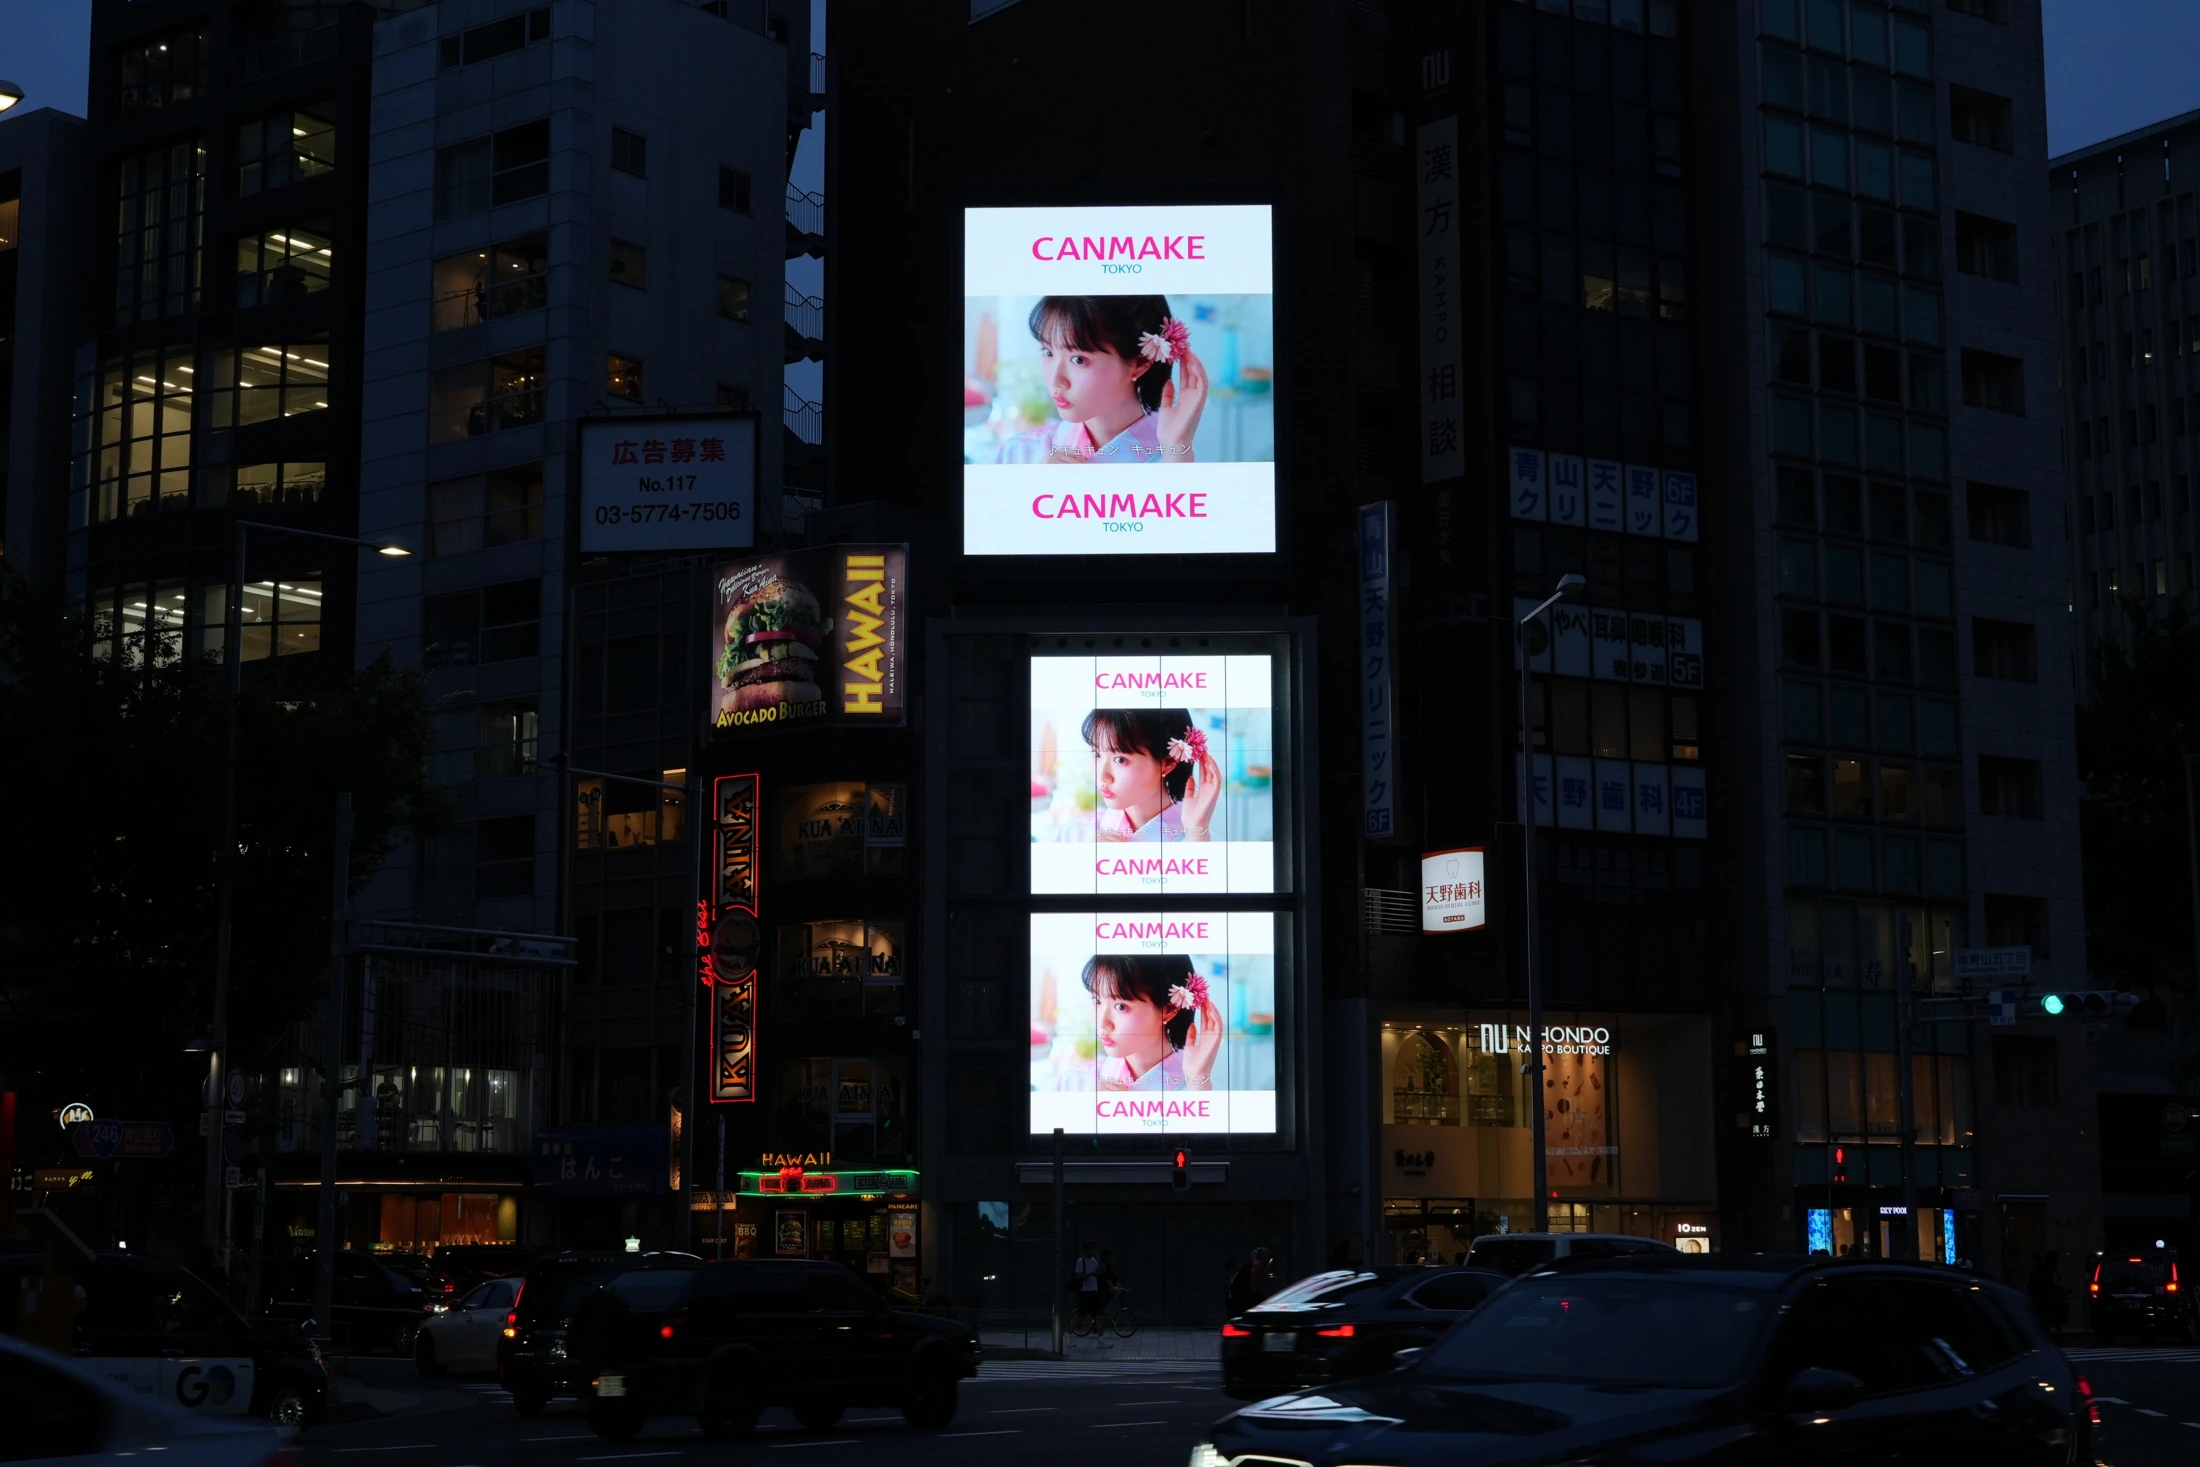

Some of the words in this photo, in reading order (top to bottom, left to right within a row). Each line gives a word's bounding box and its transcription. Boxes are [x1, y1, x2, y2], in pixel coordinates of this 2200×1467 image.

[1424, 143, 1453, 237] 漢方
[1031, 236, 1206, 261] CANMAKE
[1101, 264, 1143, 274] TOKYO
[1432, 256, 1448, 343] KAMPO
[1427, 363, 1458, 458] 相談
[612, 437, 726, 466] 広告募集
[1060, 444, 1120, 456] キュキュン
[1130, 444, 1191, 456] キュキュン
[638, 475, 697, 493] No.117
[1516, 452, 1655, 499] 青山天野
[1666, 475, 1694, 504] 6F
[595, 501, 741, 525] 03-5774-7506
[1031, 493, 1207, 519] CANMAKE
[1518, 488, 1691, 536] クリニック
[1102, 522, 1144, 532] TOKYO
[844, 555, 887, 714] HAWAII
[1364, 512, 1387, 804] 青山天野クリニック
[1612, 659, 1666, 682] 表参道
[1673, 654, 1700, 684] 5F
[1096, 672, 1208, 689] CANMAKE
[1533, 776, 1664, 815] 天野歯科
[1675, 789, 1704, 818] 4F
[799, 819, 832, 838] KUA
[1105, 826, 1153, 836] キュキュン
[1161, 826, 1208, 836] キュキュン
[1367, 810, 1390, 833] 6F
[1096, 859, 1209, 876] CANMAKE
[1141, 877, 1168, 885] TOKYO
[1425, 880, 1482, 905] 天野歯科
[1096, 923, 1209, 939] CANMAKE
[798, 954, 832, 976] KUA
[1957, 951, 2027, 967] 南青山五丁目
[720, 979, 752, 1092] KUA
[1516, 1025, 1610, 1044] NHONDO
[1557, 1045, 1610, 1056] BOUTIQUE
[230, 1079, 244, 1098] 40
[1162, 1075, 1211, 1085] キュキュン
[1096, 1101, 1211, 1117] CANMAKE
[1142, 1119, 1169, 1127] TOKYO
[92, 1123, 119, 1145] 246
[560, 1154, 624, 1180] はんこ
[761, 1151, 832, 1167] HAWAII
[738, 1227, 757, 1238] BBQ
